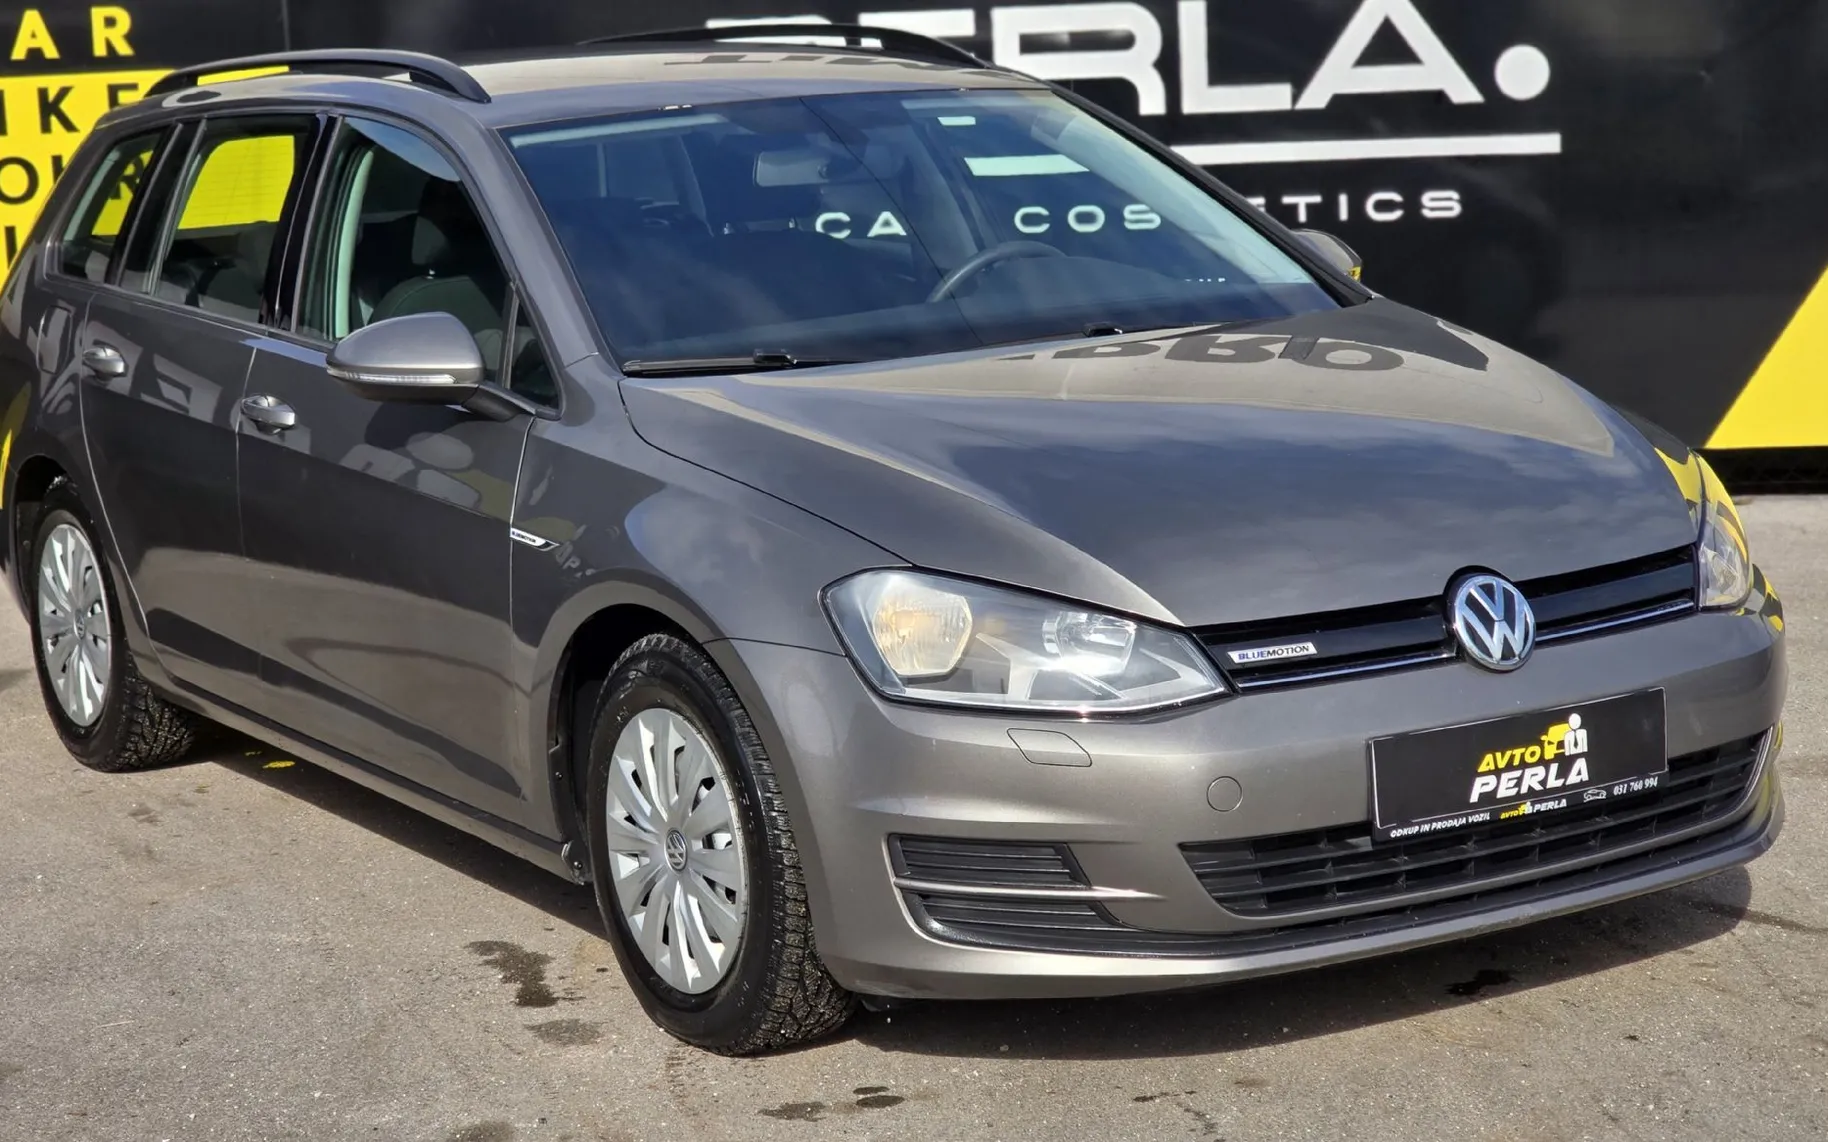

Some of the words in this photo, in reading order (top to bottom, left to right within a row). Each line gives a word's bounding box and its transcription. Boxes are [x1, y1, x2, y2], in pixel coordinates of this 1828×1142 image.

[704, 0, 1550, 116] RLA.
[1237, 643, 1311, 662] BLUEMOTION
[1477, 744, 1541, 773] AVTO
[1469, 757, 1590, 803] PERLA
[1533, 799, 1568, 813] PERLA
[1389, 825, 1420, 838] ODKUP
[1419, 823, 1431, 833] IN
[1431, 817, 1467, 831] PRODAJA
[1468, 812, 1491, 824] VOZIL
